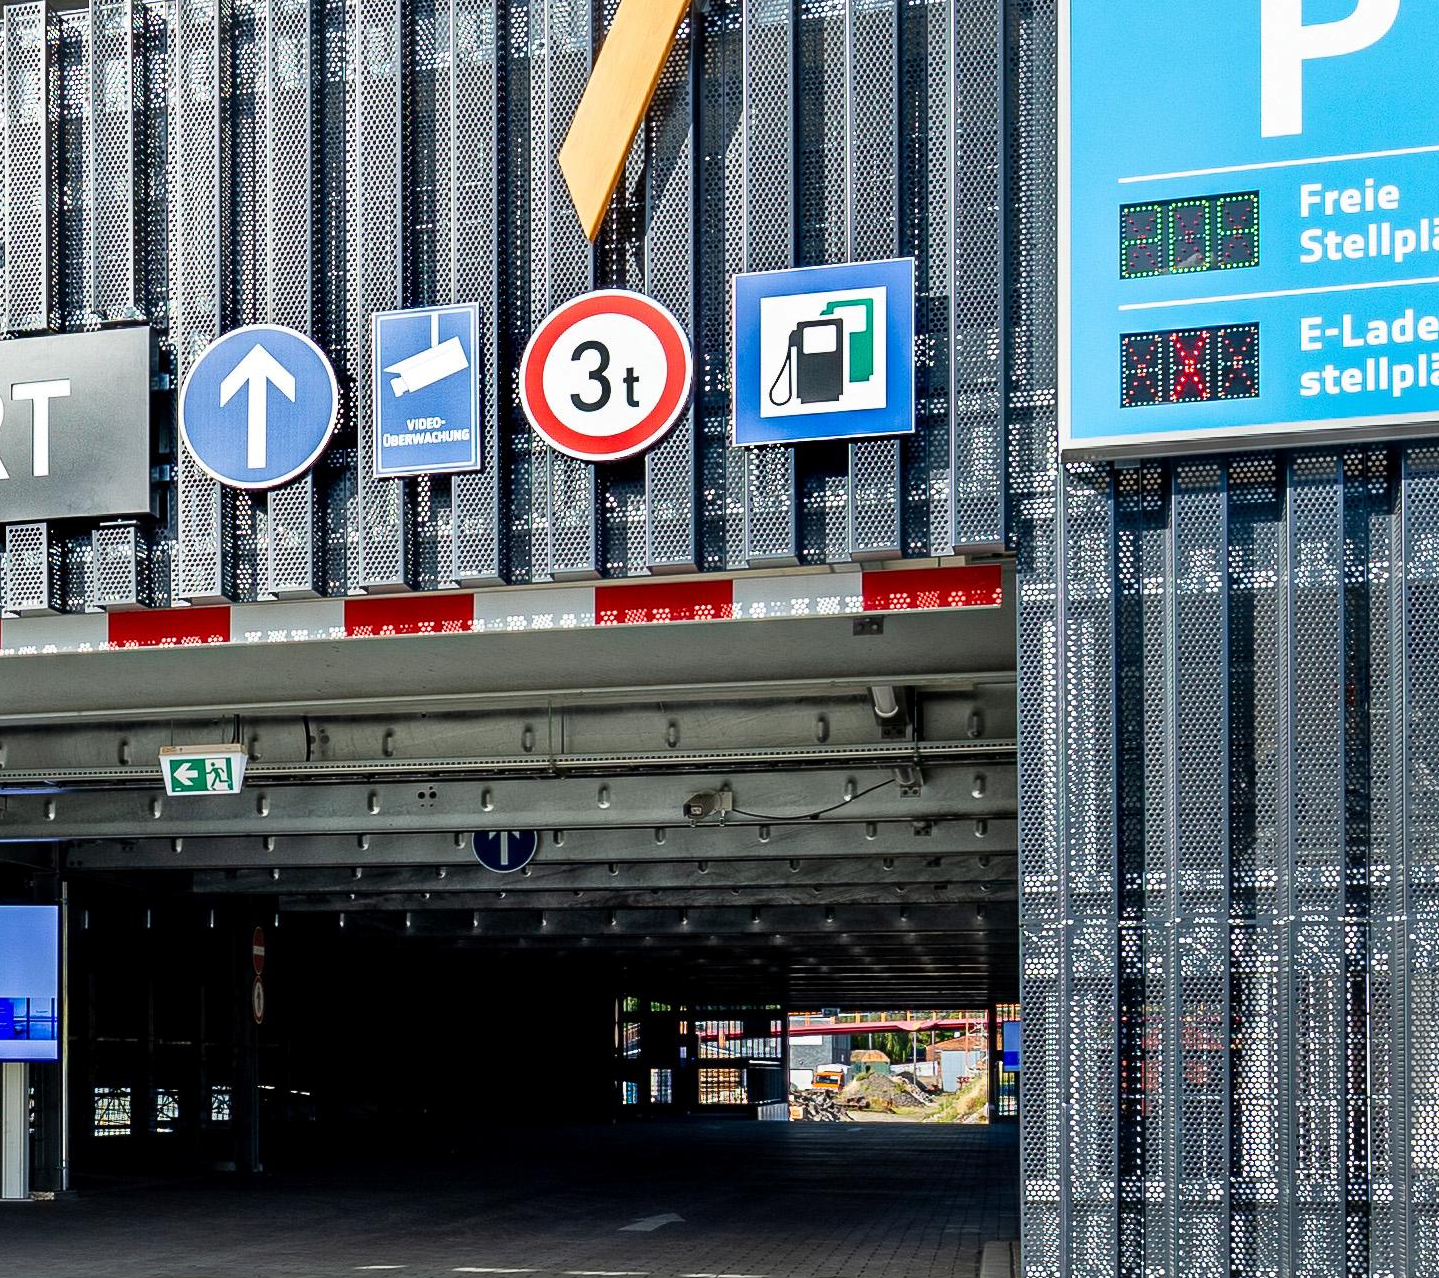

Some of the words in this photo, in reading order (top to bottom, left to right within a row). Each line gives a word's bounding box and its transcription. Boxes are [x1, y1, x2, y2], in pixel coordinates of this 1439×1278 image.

[1299, 178, 1399, 218] Freie
[571, 340, 612, 413] 3
[622, 367, 640, 408] t
[383, 429, 470, 447] ÜBERWACHUNG
[407, 417, 446, 431] VIDEO-
